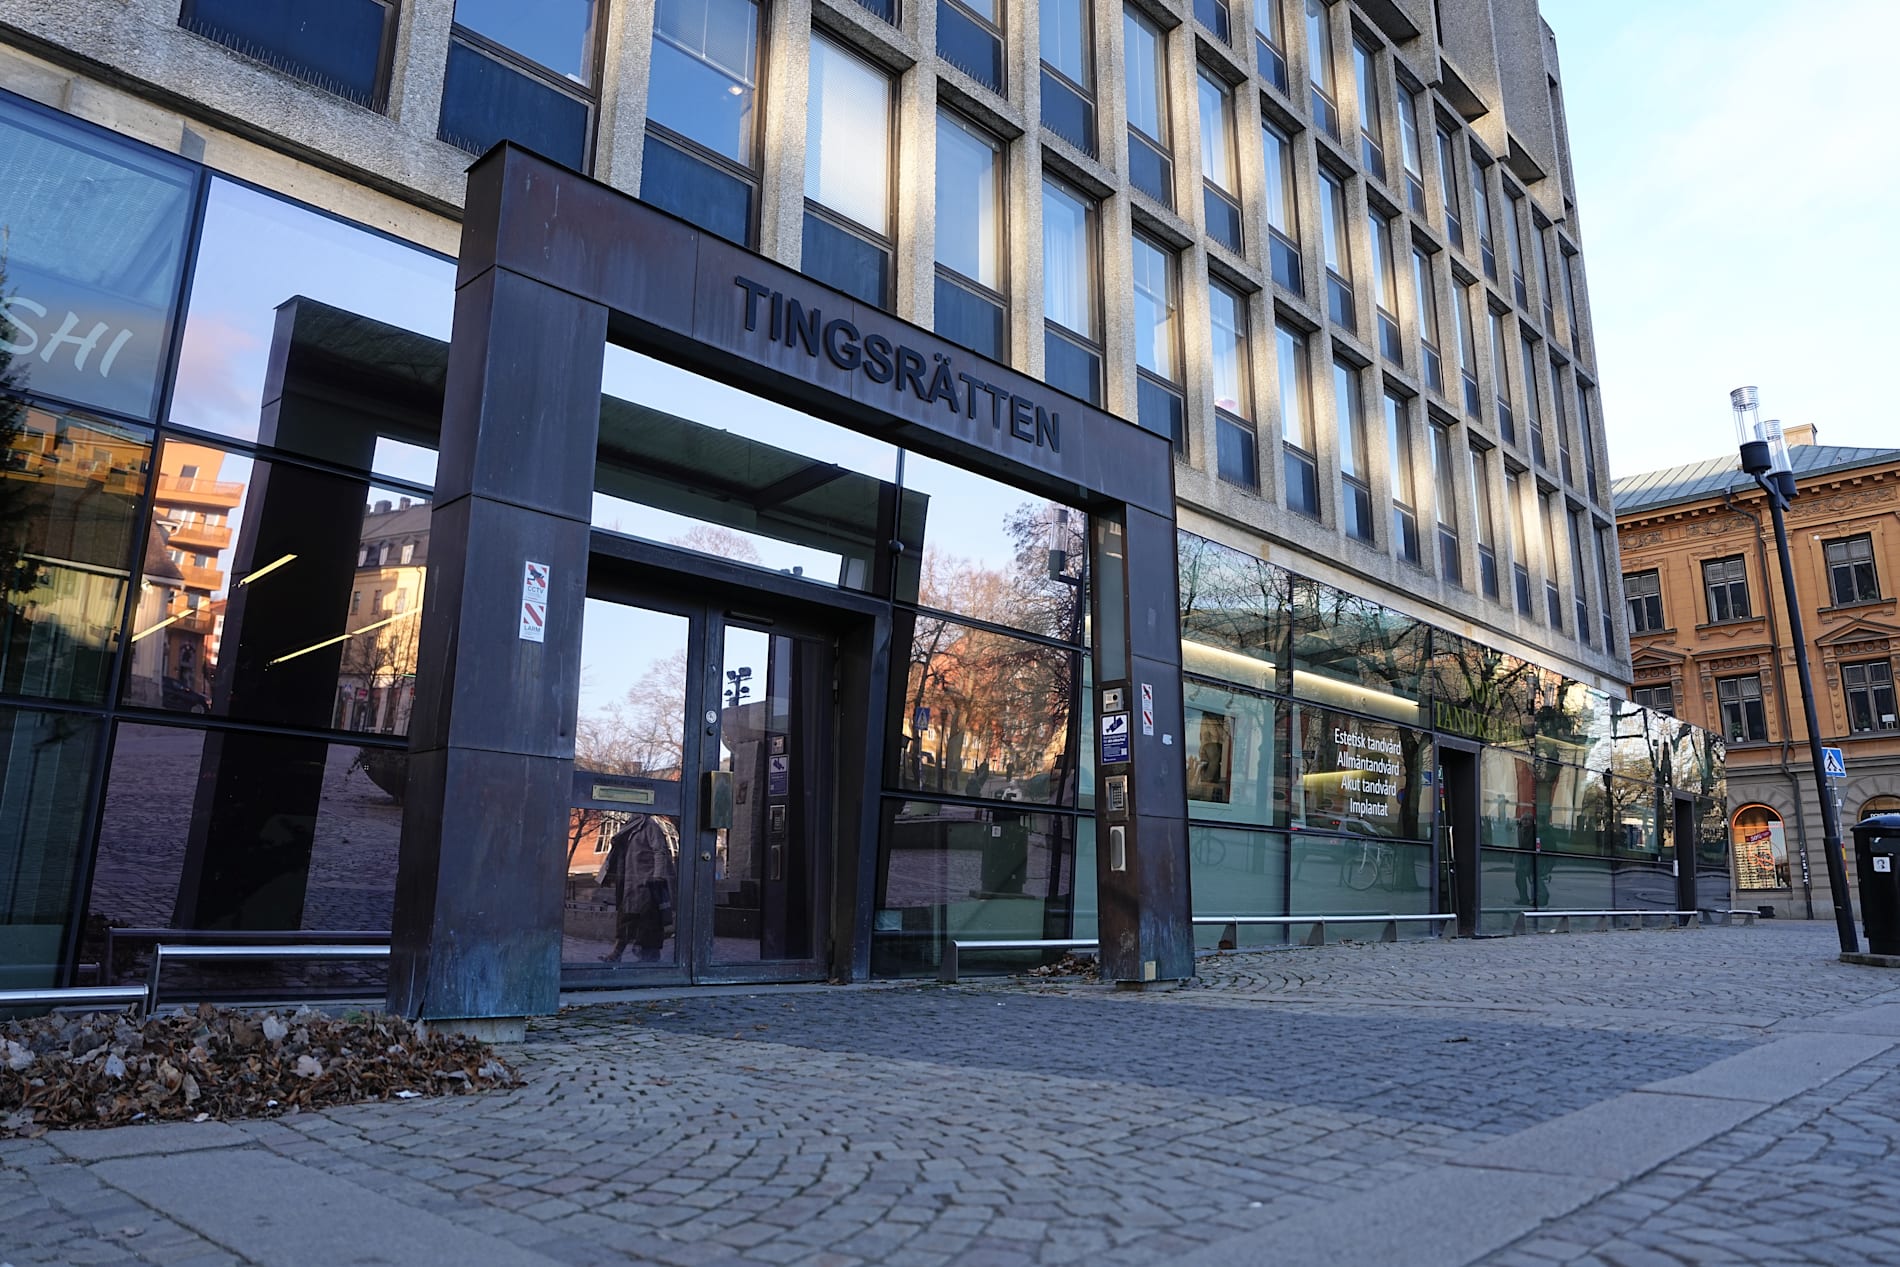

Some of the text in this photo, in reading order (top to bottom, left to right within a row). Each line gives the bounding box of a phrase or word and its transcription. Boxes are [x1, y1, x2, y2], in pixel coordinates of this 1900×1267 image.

[0, 296, 133, 378] SHI
[735, 276, 1060, 453] TINGSRÄTTEN
[527, 586, 545, 594] CCTV
[1335, 727, 1401, 756] Estetisk tandvård
[1337, 751, 1400, 776] Allmäntandvård
[1341, 775, 1397, 797] Akut tandvård
[1350, 797, 1389, 818] Implantat
